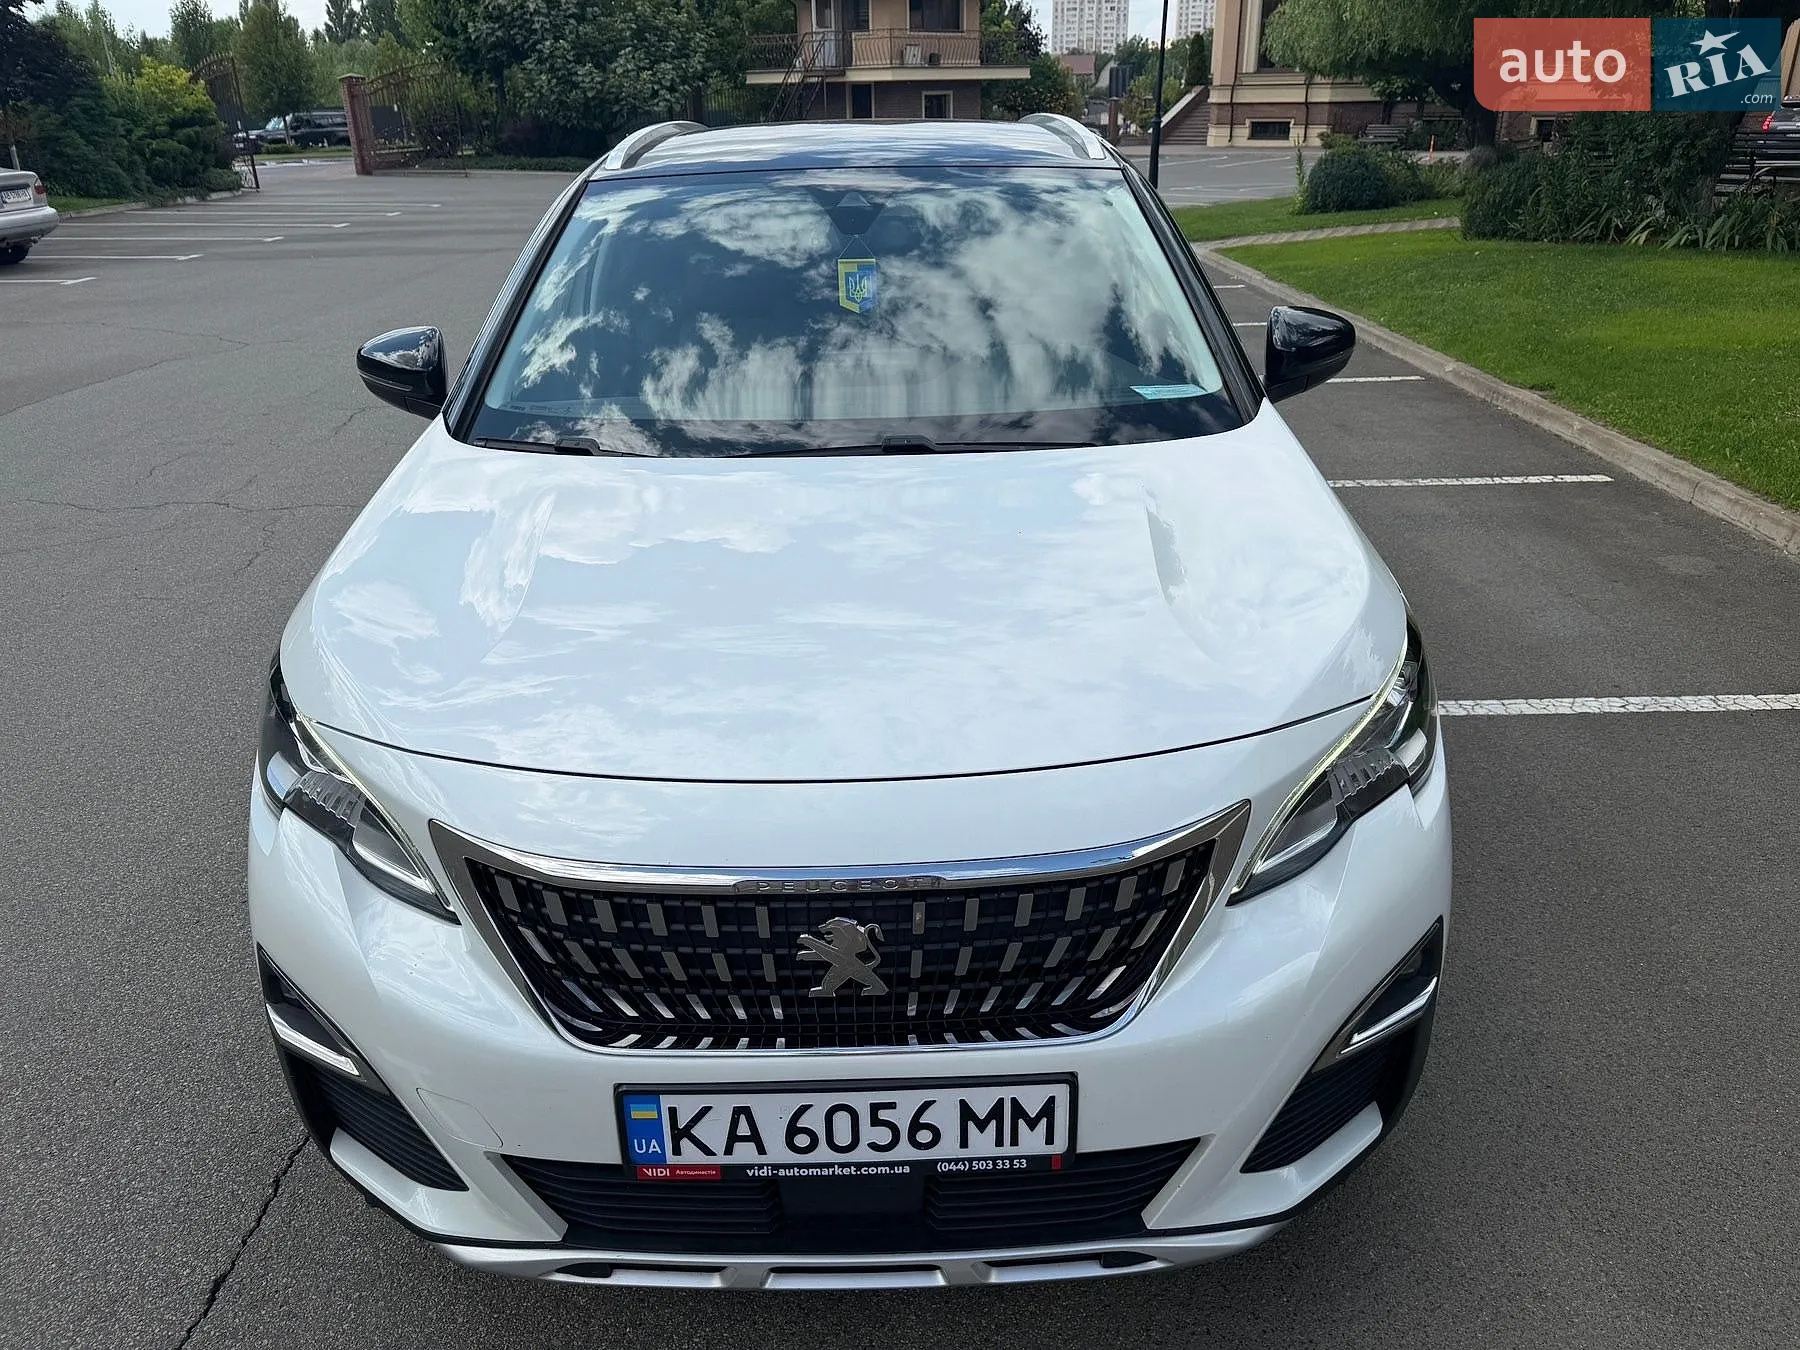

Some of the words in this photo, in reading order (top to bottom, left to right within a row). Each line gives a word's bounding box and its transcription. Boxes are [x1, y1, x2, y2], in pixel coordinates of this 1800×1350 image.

[757, 878, 923, 893] PEUGEOT
[667, 1105, 768, 1157] KA
[784, 1100, 942, 1156] 6056
[958, 1095, 1056, 1150] MM
[634, 1139, 661, 1155] UA
[746, 1165, 910, 1177] vidi-automarket.com.ua
[937, 1161, 970, 1172] (044)
[972, 1160, 993, 1170] 503
[996, 1159, 1010, 1169] 33
[1013, 1158, 1027, 1169] 53
[643, 1168, 670, 1177] VIDI
